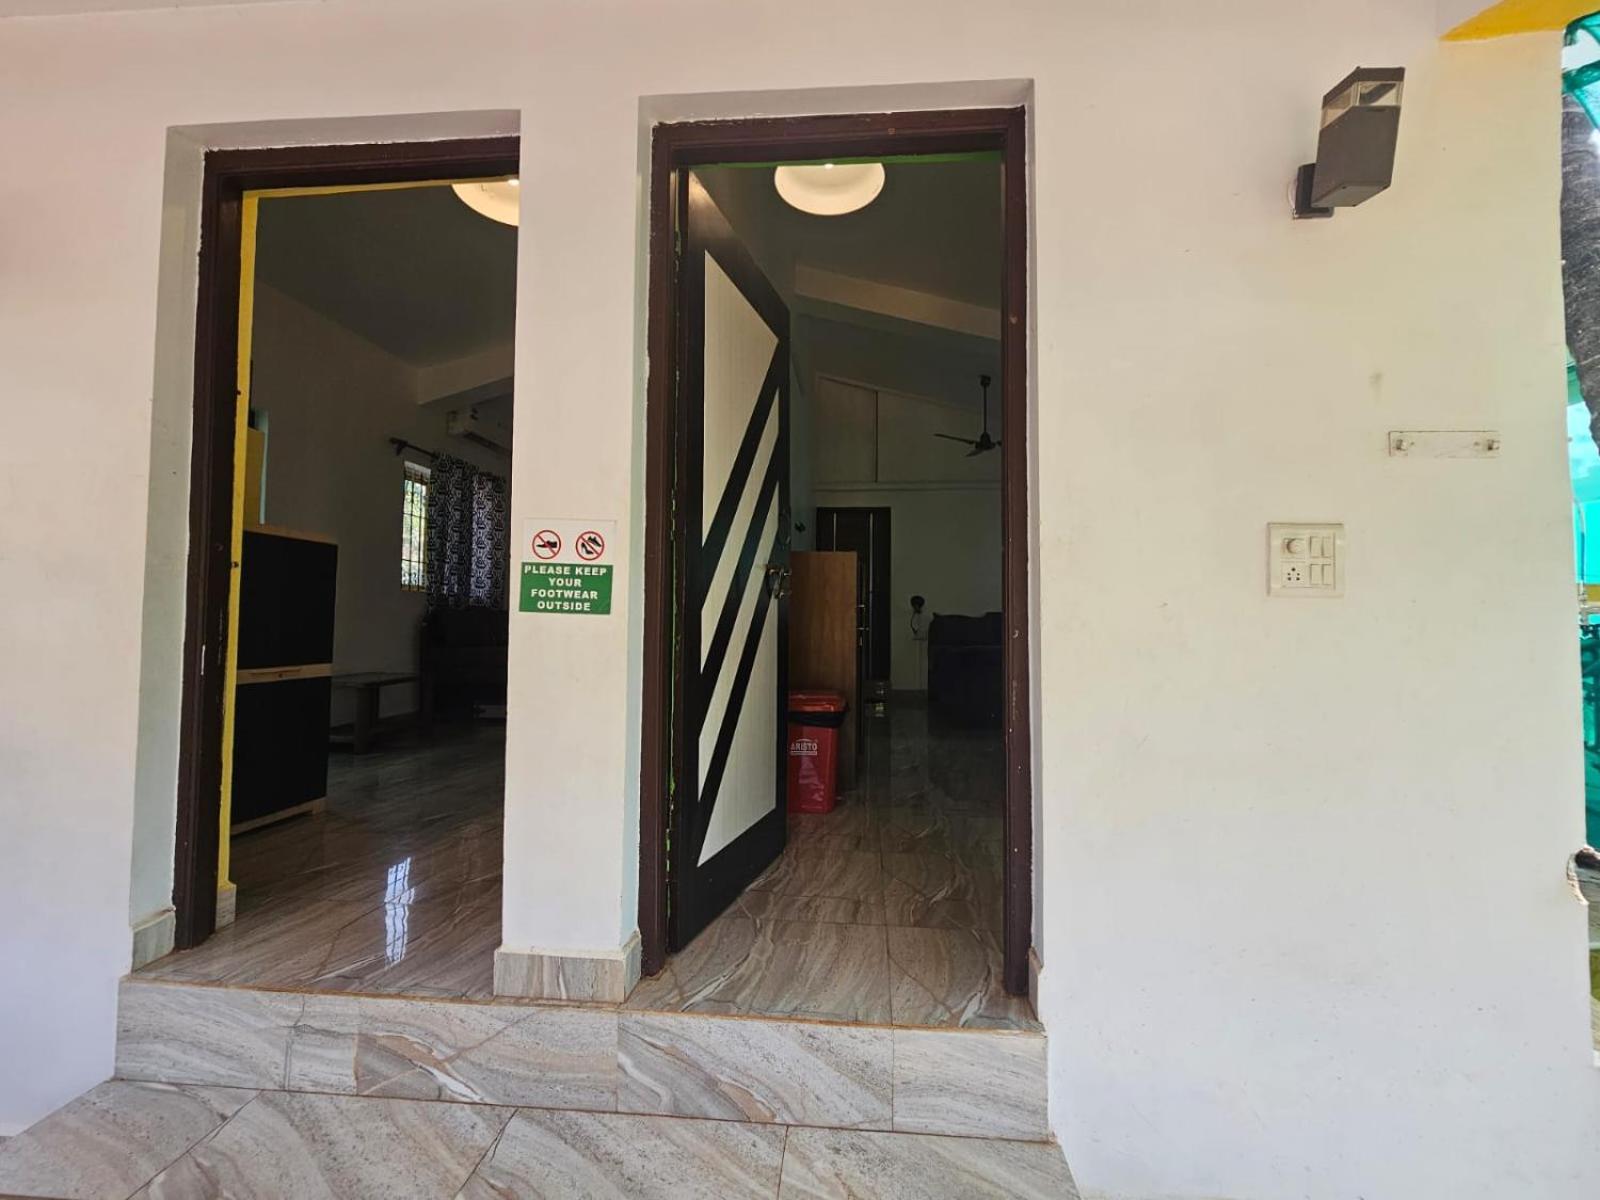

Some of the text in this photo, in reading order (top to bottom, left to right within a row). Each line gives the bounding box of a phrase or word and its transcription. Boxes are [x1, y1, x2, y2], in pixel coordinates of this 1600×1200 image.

[524, 565, 607, 576] PLEASE KEEP
[548, 577, 582, 587] YOUR
[531, 588, 598, 599] FOOTWEAR
[537, 601, 591, 611] OUTSIDE
[790, 742, 818, 751] ARISTO
